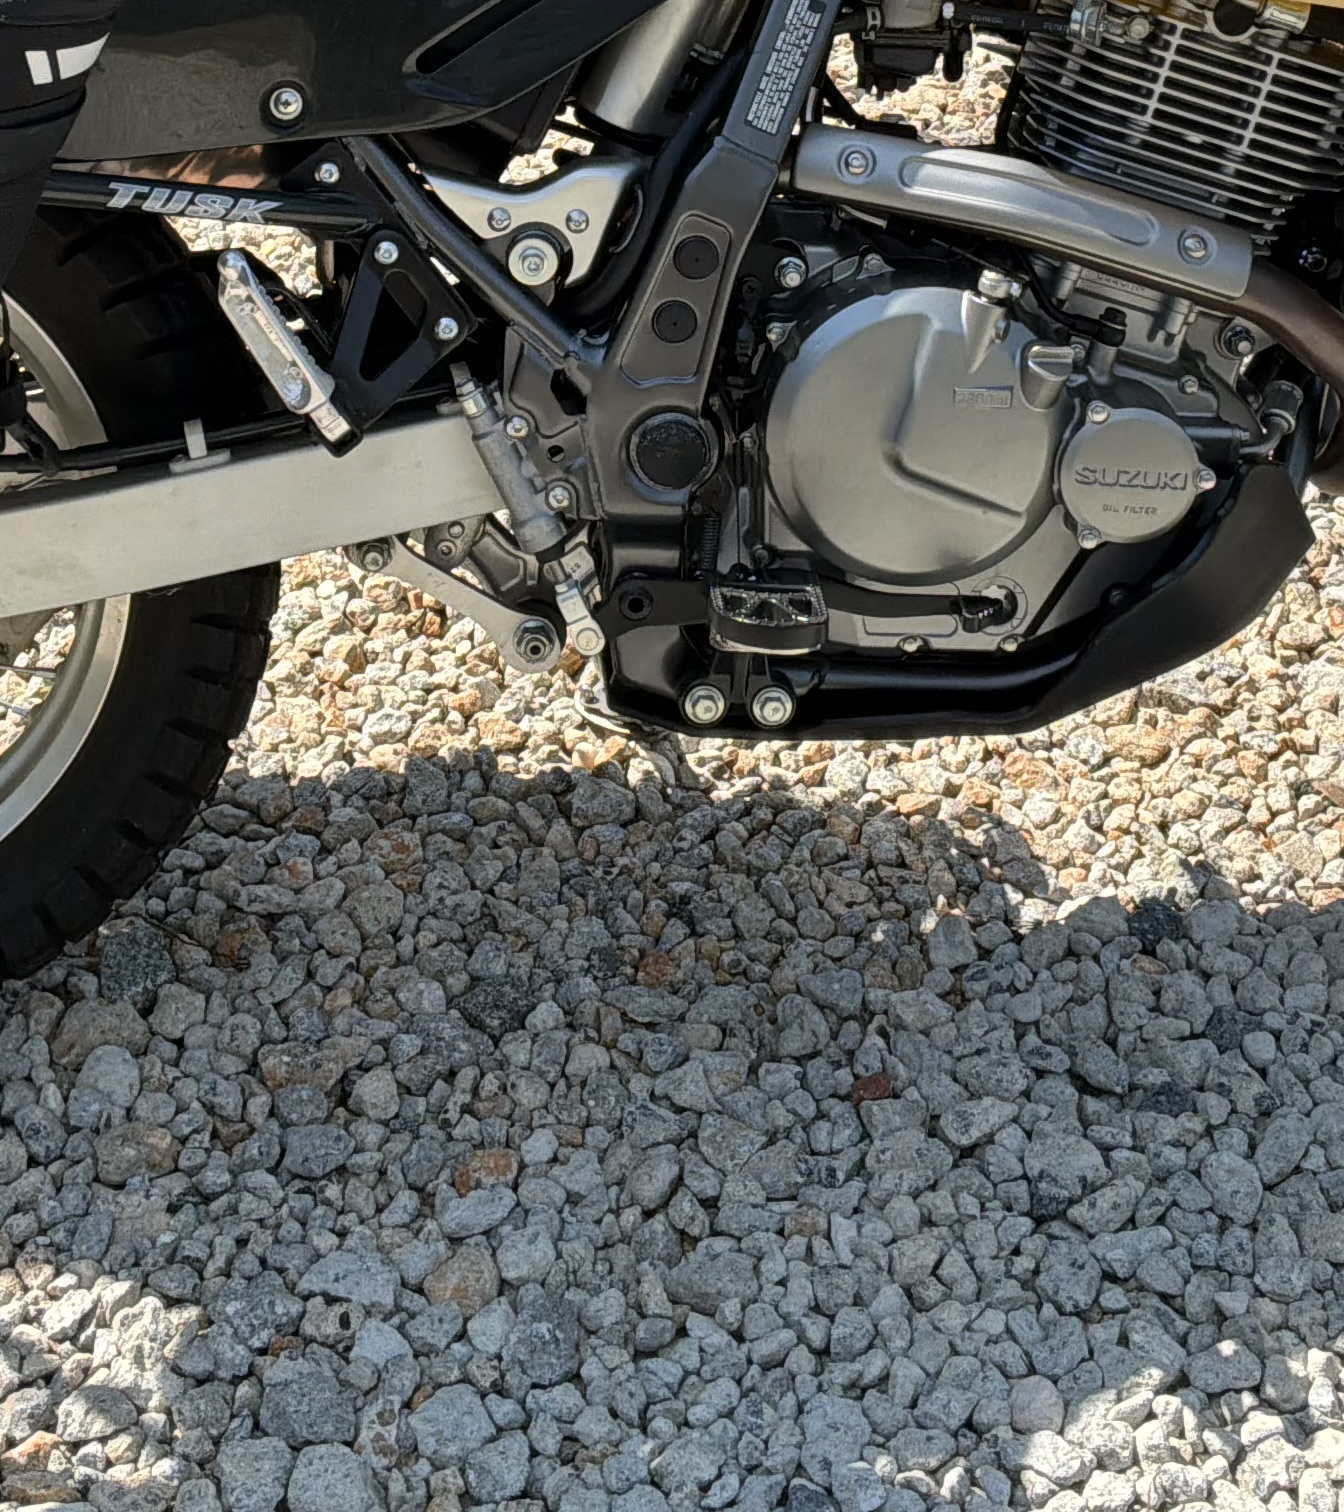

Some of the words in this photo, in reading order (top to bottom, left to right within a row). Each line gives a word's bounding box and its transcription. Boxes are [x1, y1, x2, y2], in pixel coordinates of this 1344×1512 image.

[106, 182, 284, 223] TUSK
[1075, 467, 1188, 490] SUZUKI
[1103, 504, 1119, 513] OIL
[1123, 505, 1158, 515] FILTER
